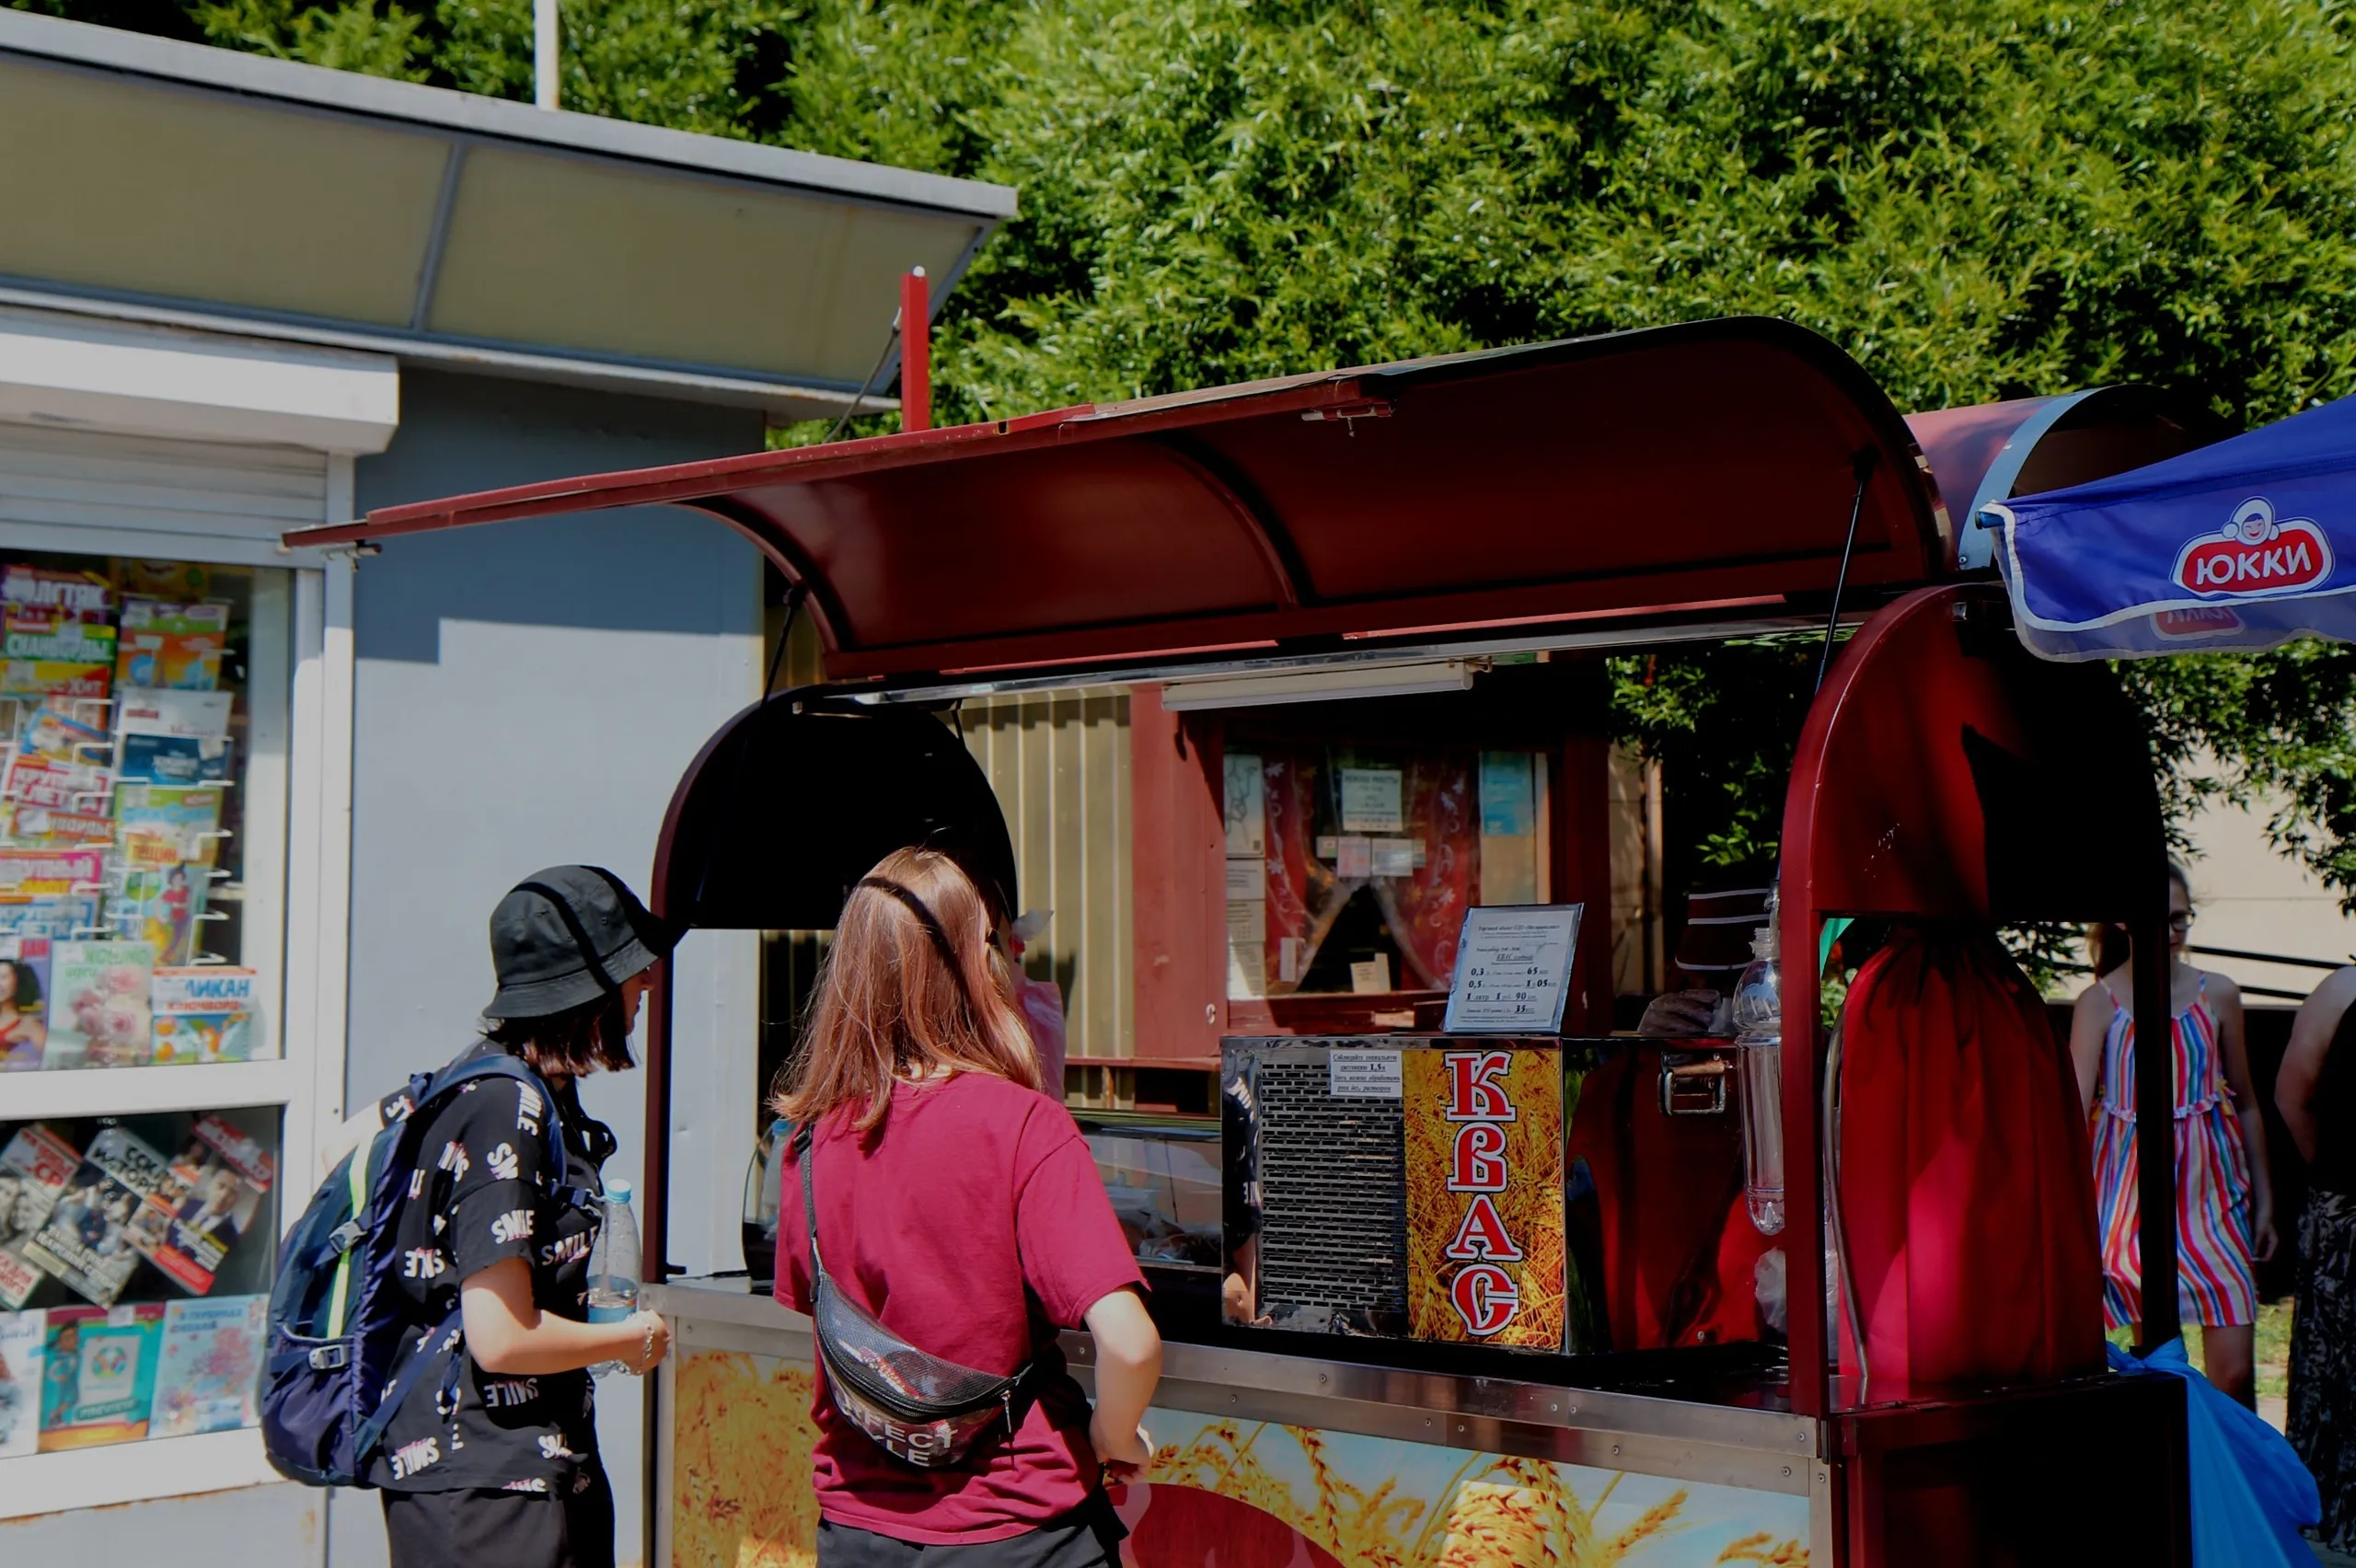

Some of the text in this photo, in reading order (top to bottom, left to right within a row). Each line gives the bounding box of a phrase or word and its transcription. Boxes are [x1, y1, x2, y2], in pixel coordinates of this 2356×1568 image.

[2196, 541, 2312, 585] ЮККИ
[1471, 967, 1484, 976] 0,3
[1527, 967, 1538, 975] 65
[187, 978, 250, 997] ЛИКАН
[1468, 979, 1482, 988] 0,5
[1537, 979, 1548, 987] 05
[1516, 992, 1527, 1000] 90
[1516, 1005, 1526, 1013] 35
[1445, 1051, 1524, 1336] КВАС
[483, 1377, 539, 1408] SMILE
[390, 1435, 440, 1481] SMILE
